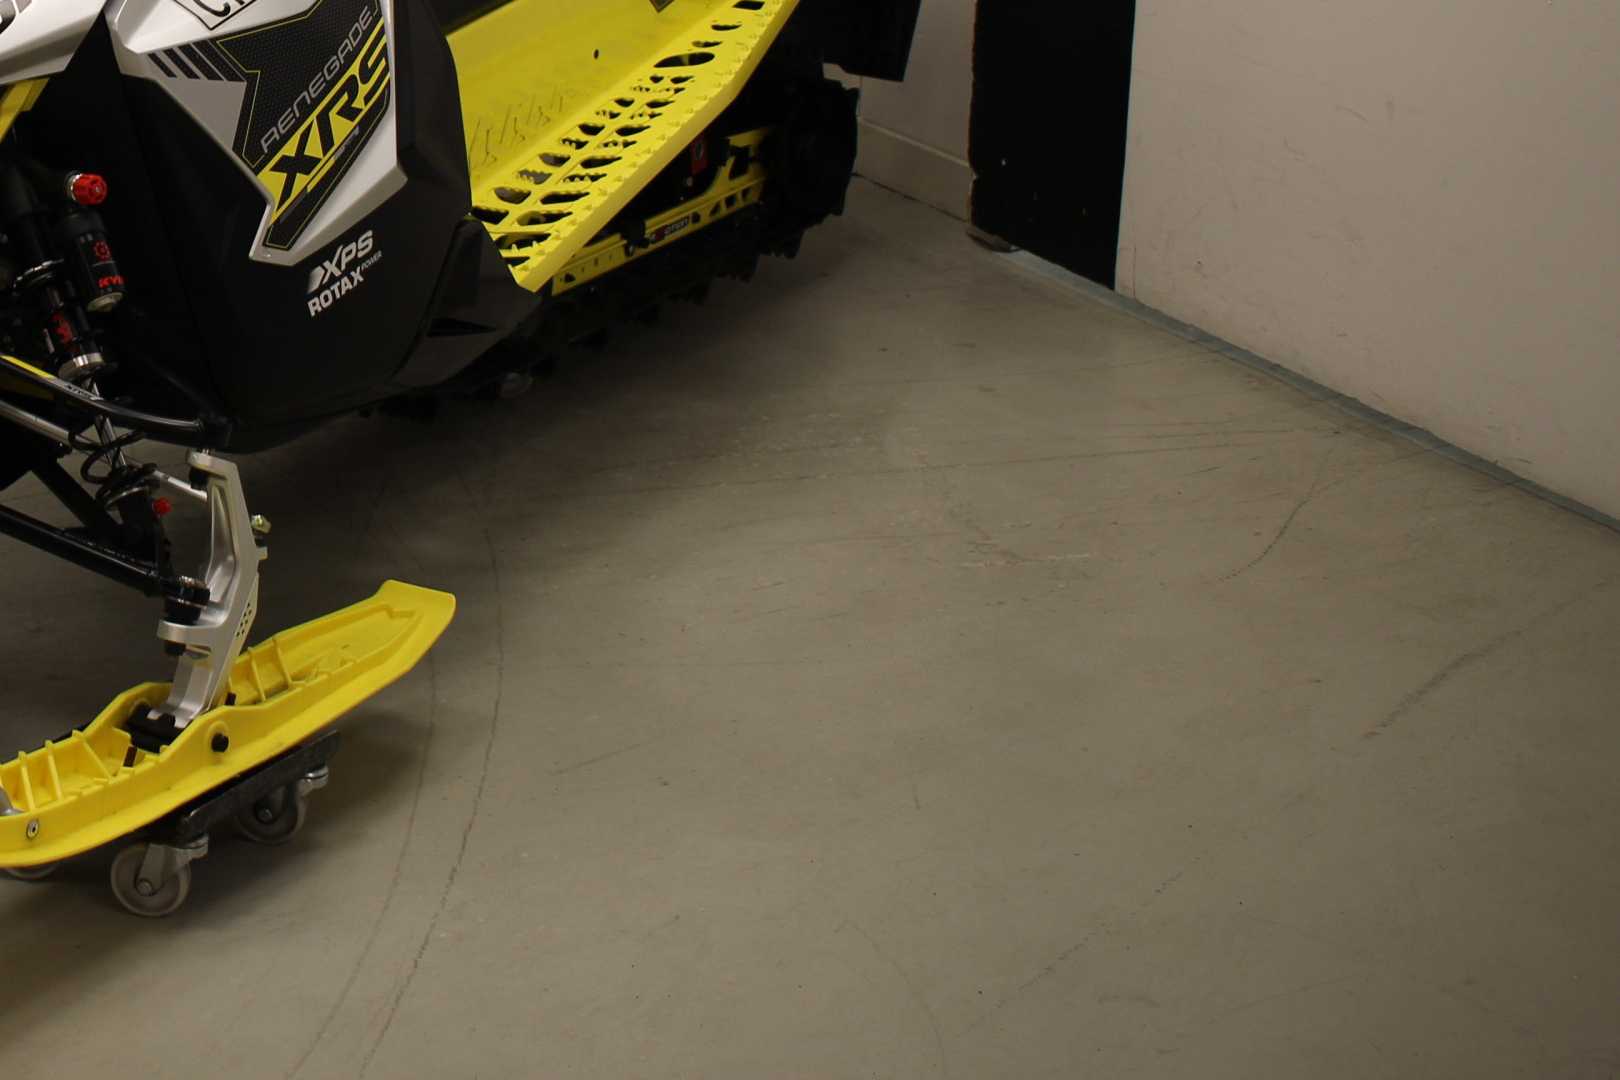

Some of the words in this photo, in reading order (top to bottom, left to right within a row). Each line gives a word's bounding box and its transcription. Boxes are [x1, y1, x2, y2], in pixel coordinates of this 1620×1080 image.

[260, 5, 374, 154] RENEGADE
[269, 24, 390, 213] XRS
[307, 266, 364, 317] ROTAX
[321, 230, 374, 285] XPS
